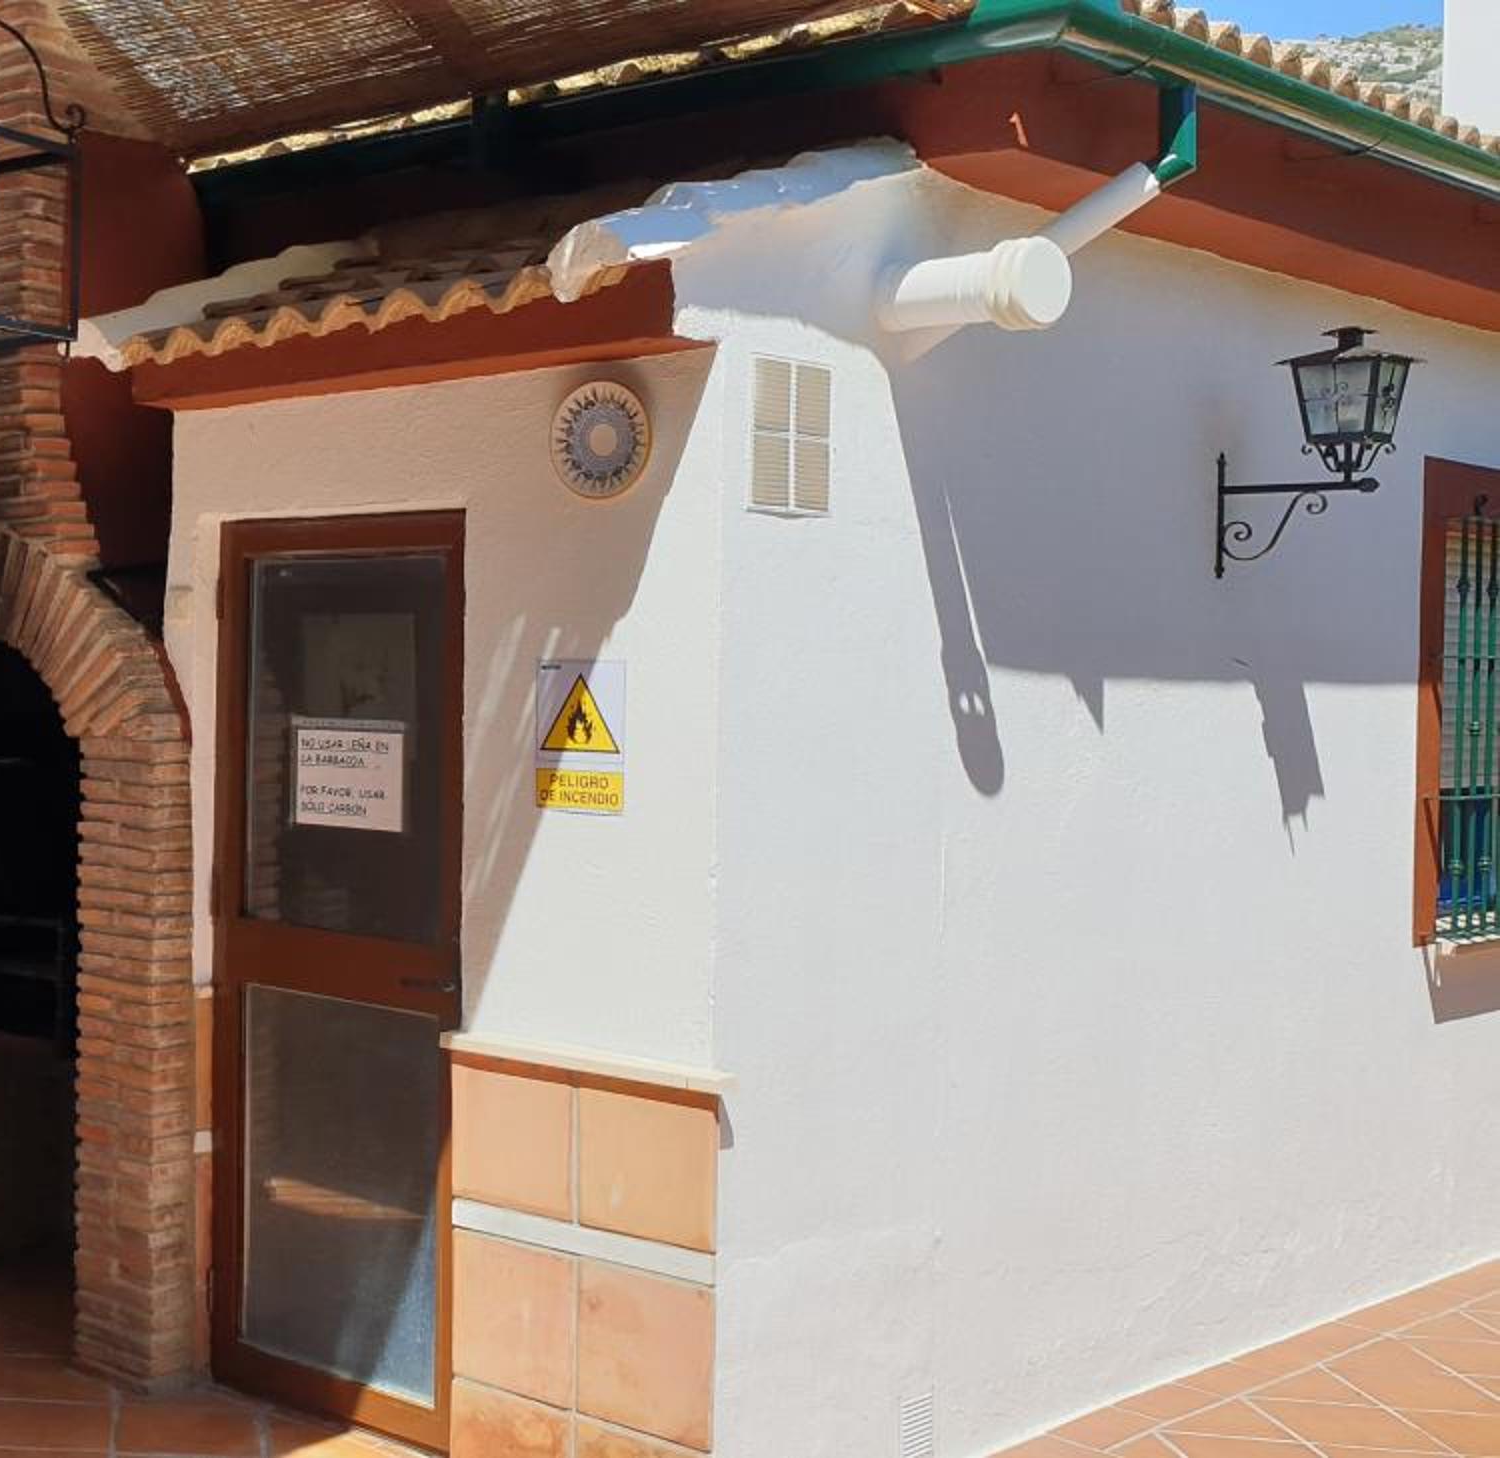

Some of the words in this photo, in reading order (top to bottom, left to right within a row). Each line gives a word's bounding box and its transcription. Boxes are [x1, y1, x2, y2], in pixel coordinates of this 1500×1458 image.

[301, 738, 315, 748] NO
[319, 739, 343, 749] USAR
[375, 741, 389, 752] EN
[301, 755, 312, 765] LA
[549, 773, 609, 789] PELIGRO
[301, 785, 318, 795] POR
[359, 789, 385, 800] USAR
[540, 789, 555, 801] DE
[559, 789, 619, 807] INCENDIO
